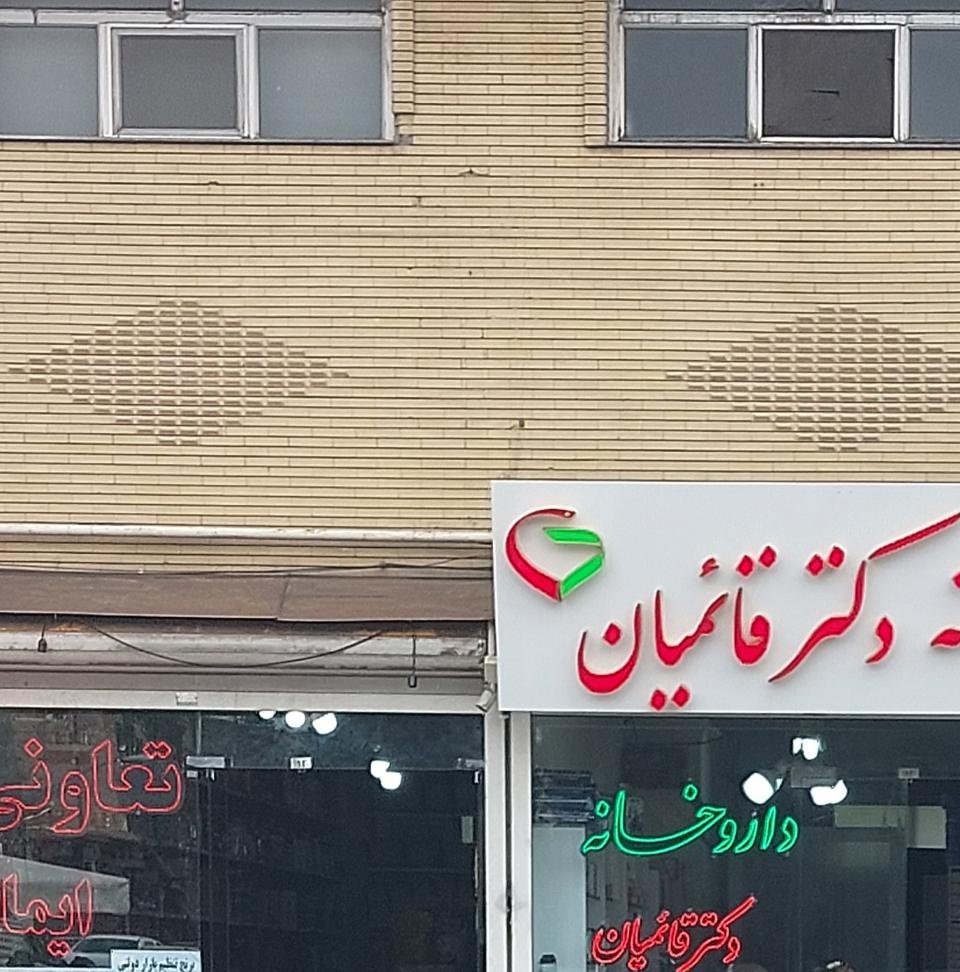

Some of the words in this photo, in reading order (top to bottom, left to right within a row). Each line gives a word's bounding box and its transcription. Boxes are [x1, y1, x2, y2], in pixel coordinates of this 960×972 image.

[577, 545, 778, 711] قائمیان
[581, 783, 799, 856] داروخانه
[0, 873, 94, 957] ایما
[592, 910, 698, 971] قائمیان
[141, 956, 158, 972] بازار
